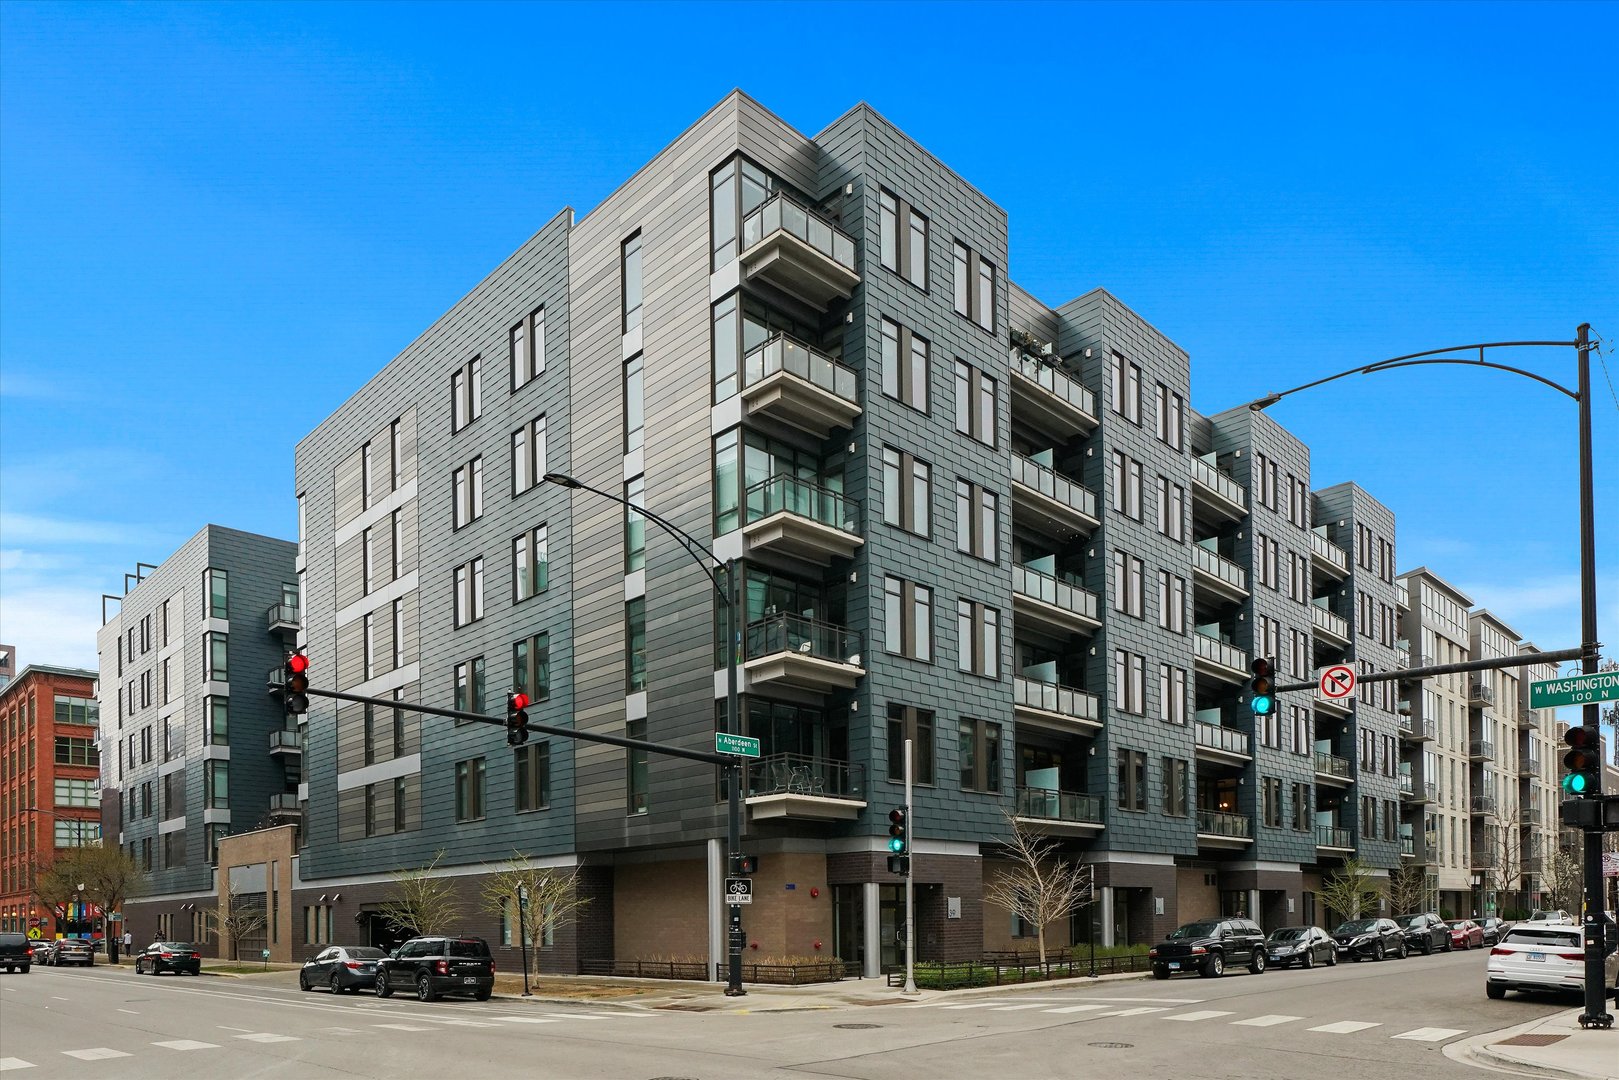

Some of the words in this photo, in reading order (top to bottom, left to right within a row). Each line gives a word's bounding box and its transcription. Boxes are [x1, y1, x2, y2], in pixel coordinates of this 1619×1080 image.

[1535, 686, 1542, 694] W
[1546, 675, 1619, 695] WASHINGTON
[1571, 692, 1592, 702] 100
[1601, 690, 1609, 698] N
[724, 737, 751, 748] Aberdeen
